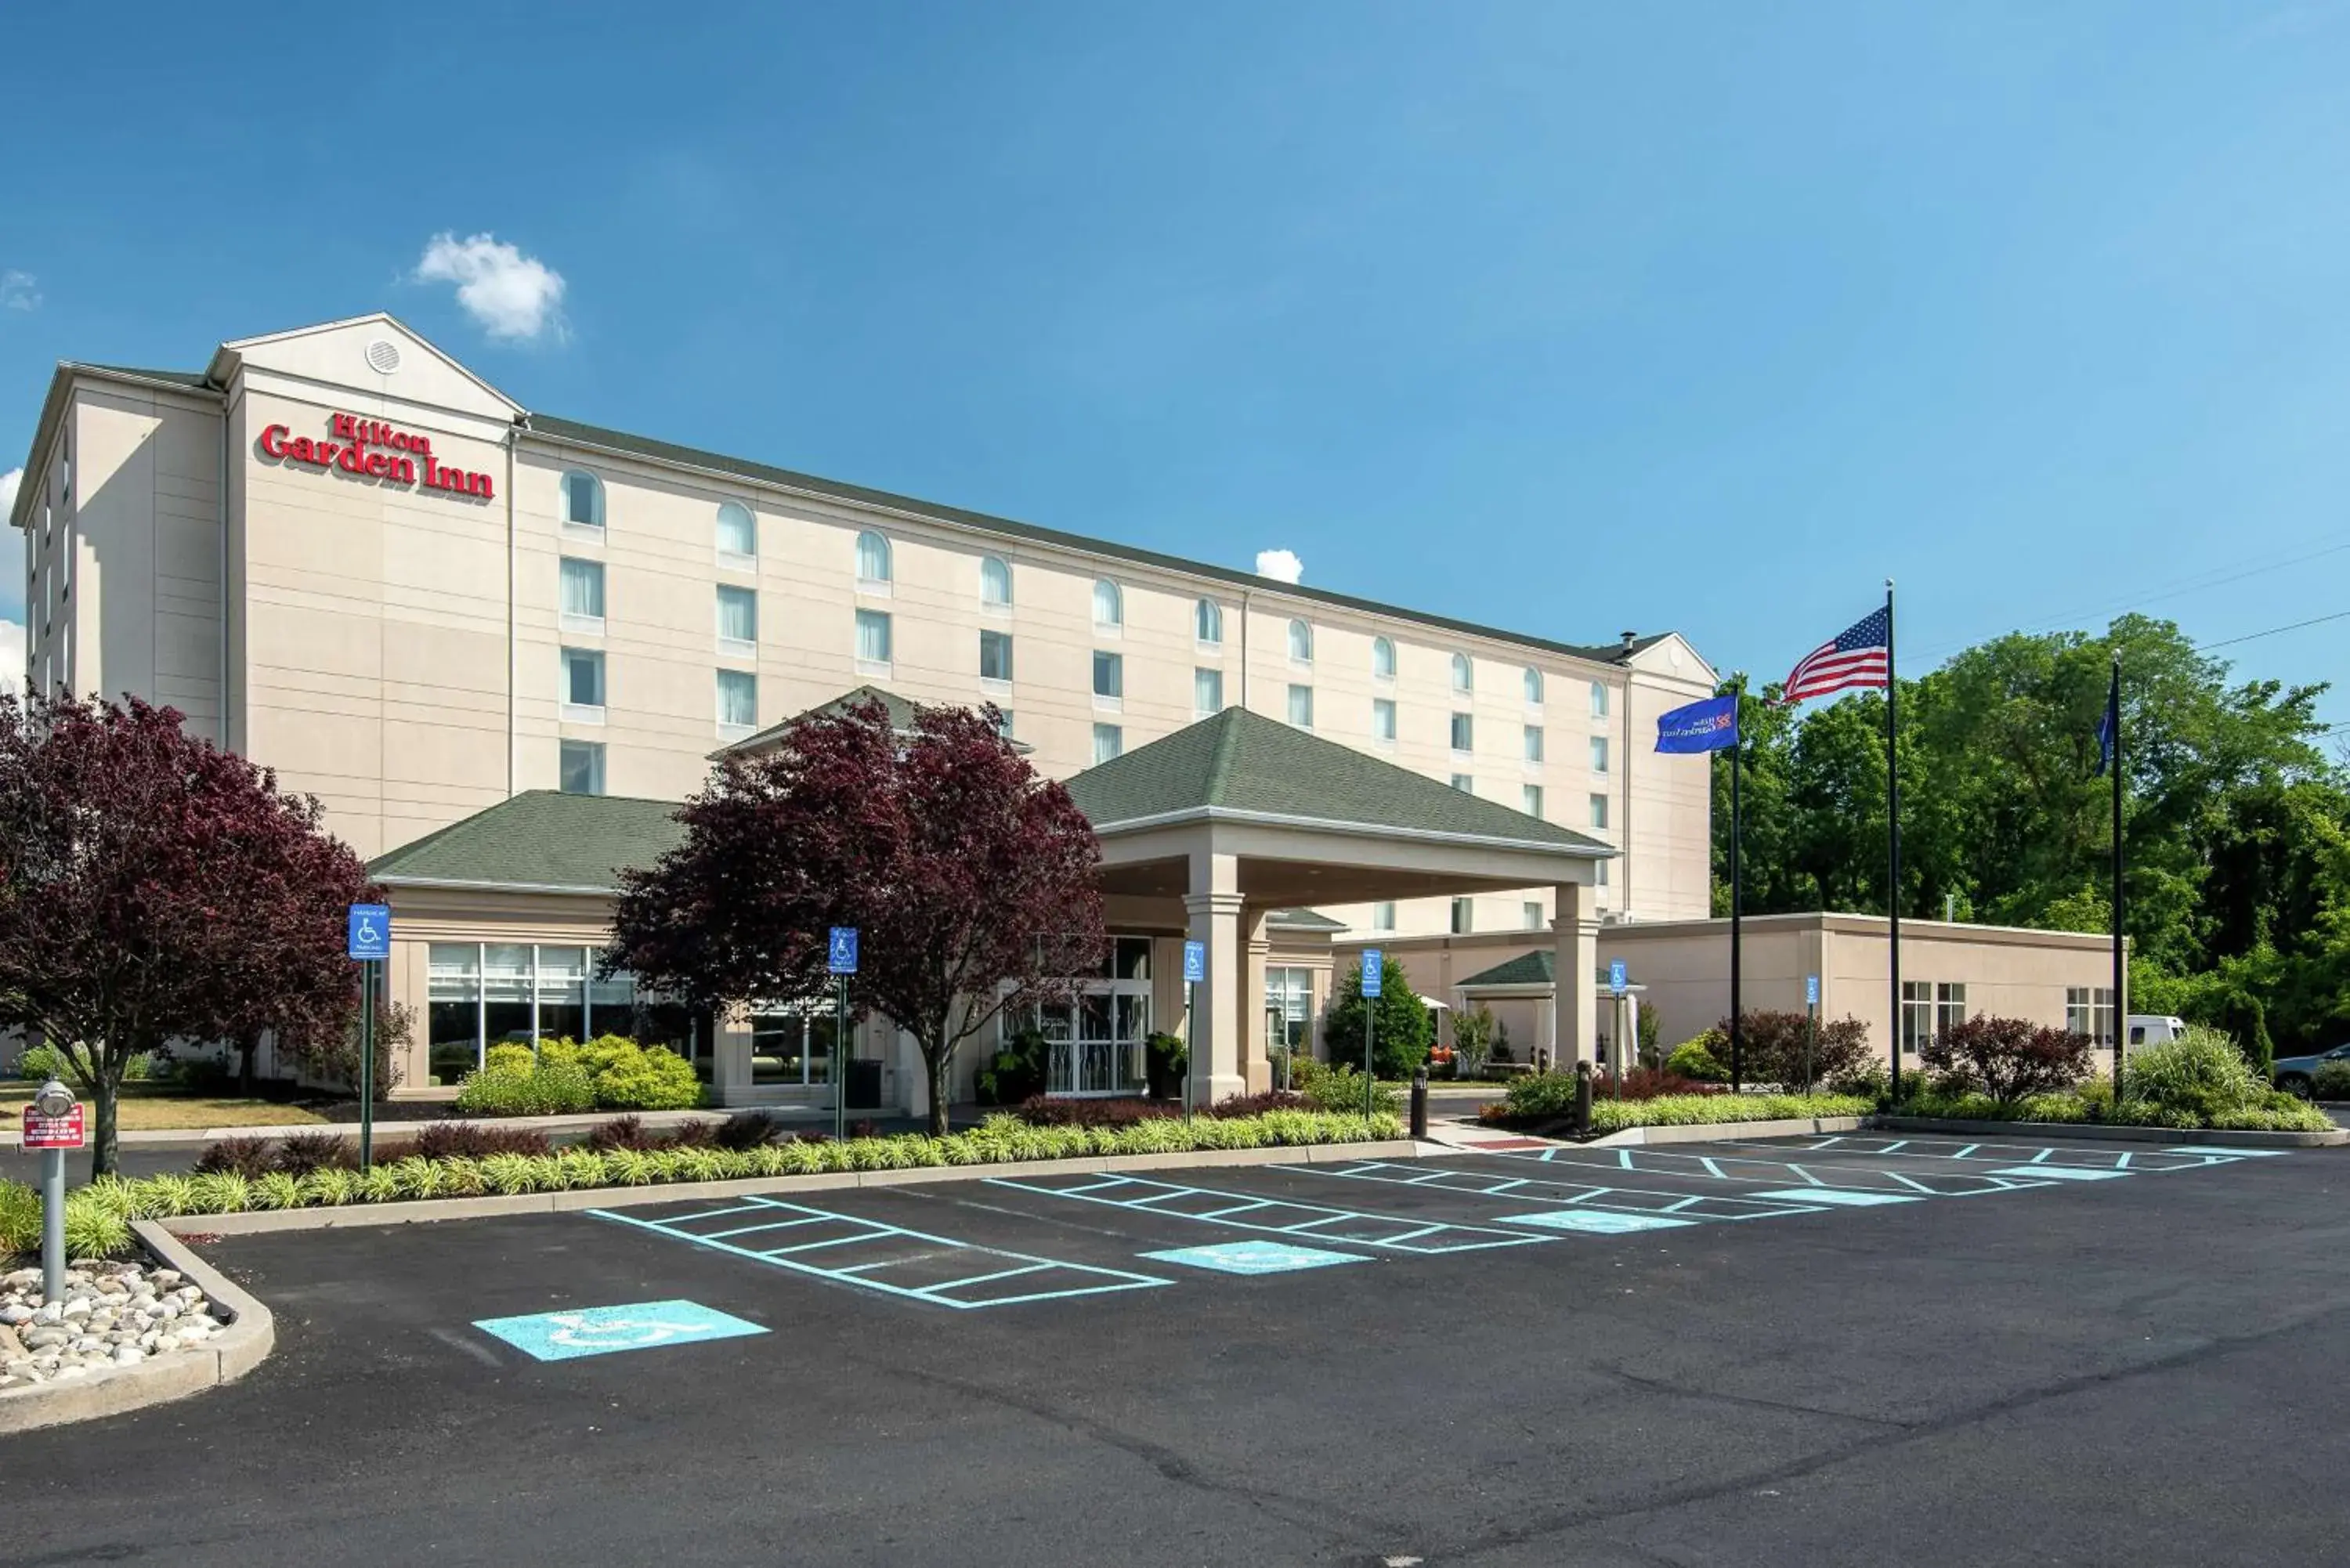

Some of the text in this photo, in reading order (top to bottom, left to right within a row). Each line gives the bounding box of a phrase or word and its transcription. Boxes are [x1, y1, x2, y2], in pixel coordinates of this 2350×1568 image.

[260, 424, 494, 500] Garden Inn
[332, 412, 432, 455] Hilton
